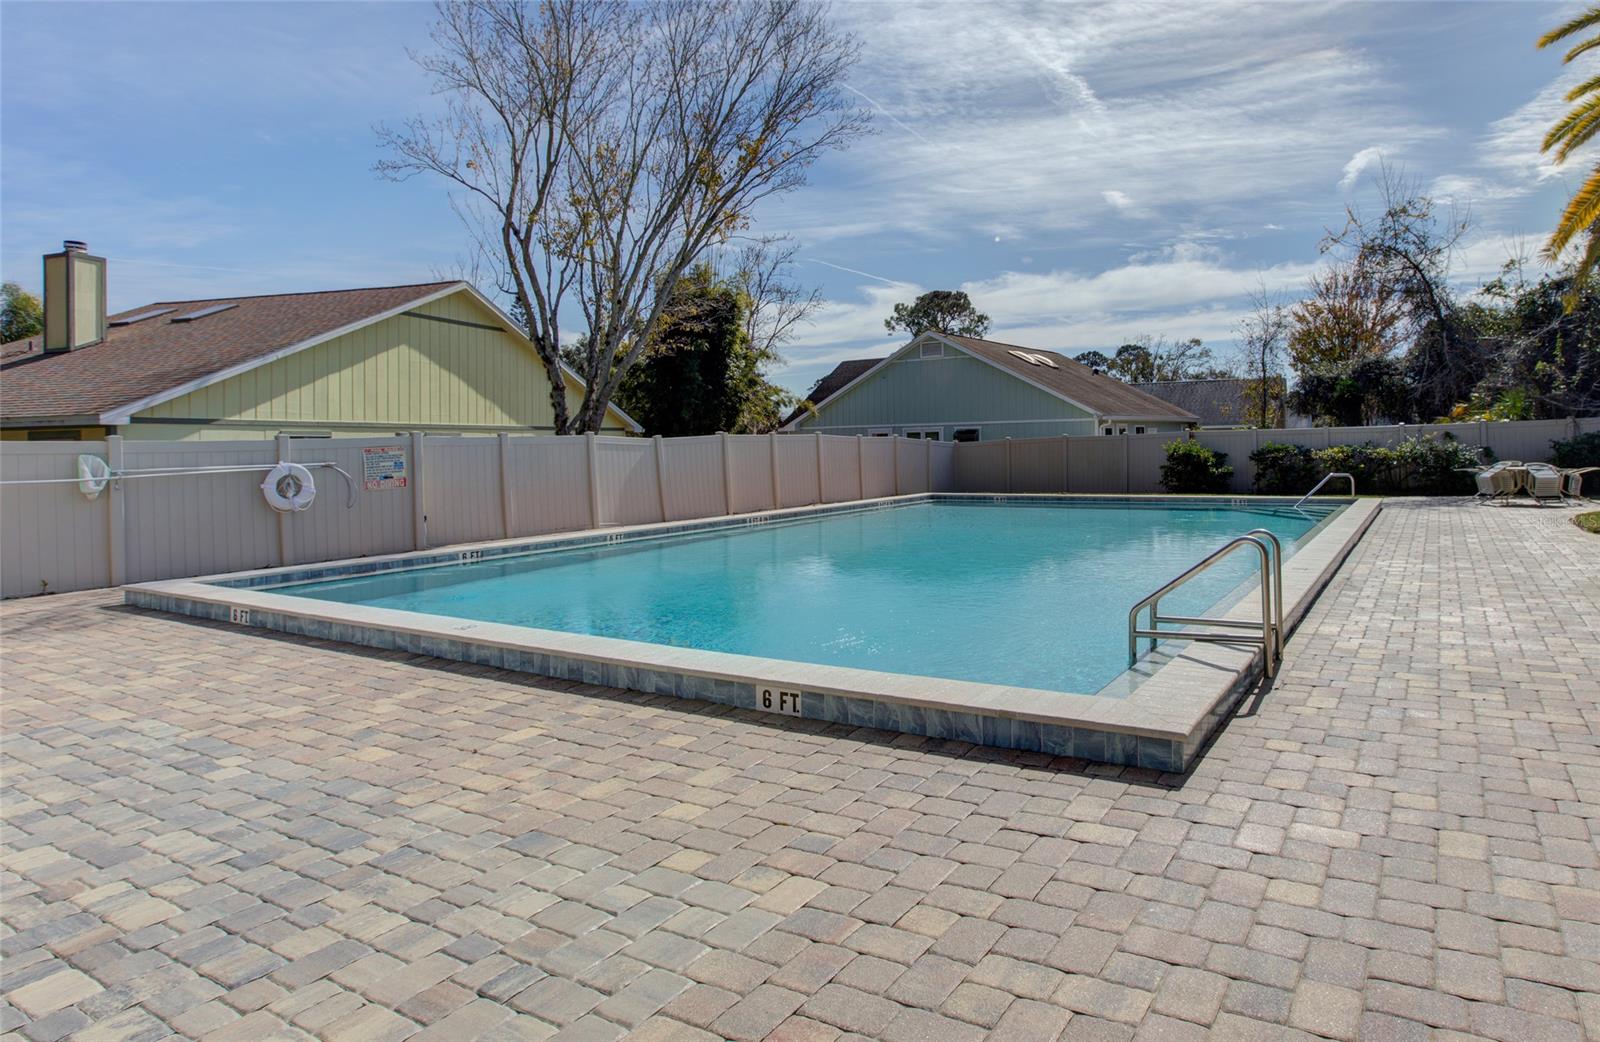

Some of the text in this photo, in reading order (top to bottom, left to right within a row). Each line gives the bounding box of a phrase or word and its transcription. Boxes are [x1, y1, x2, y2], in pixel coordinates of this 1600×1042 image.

[233, 608, 238, 622] 6
[762, 689, 800, 713] 6 FT.
